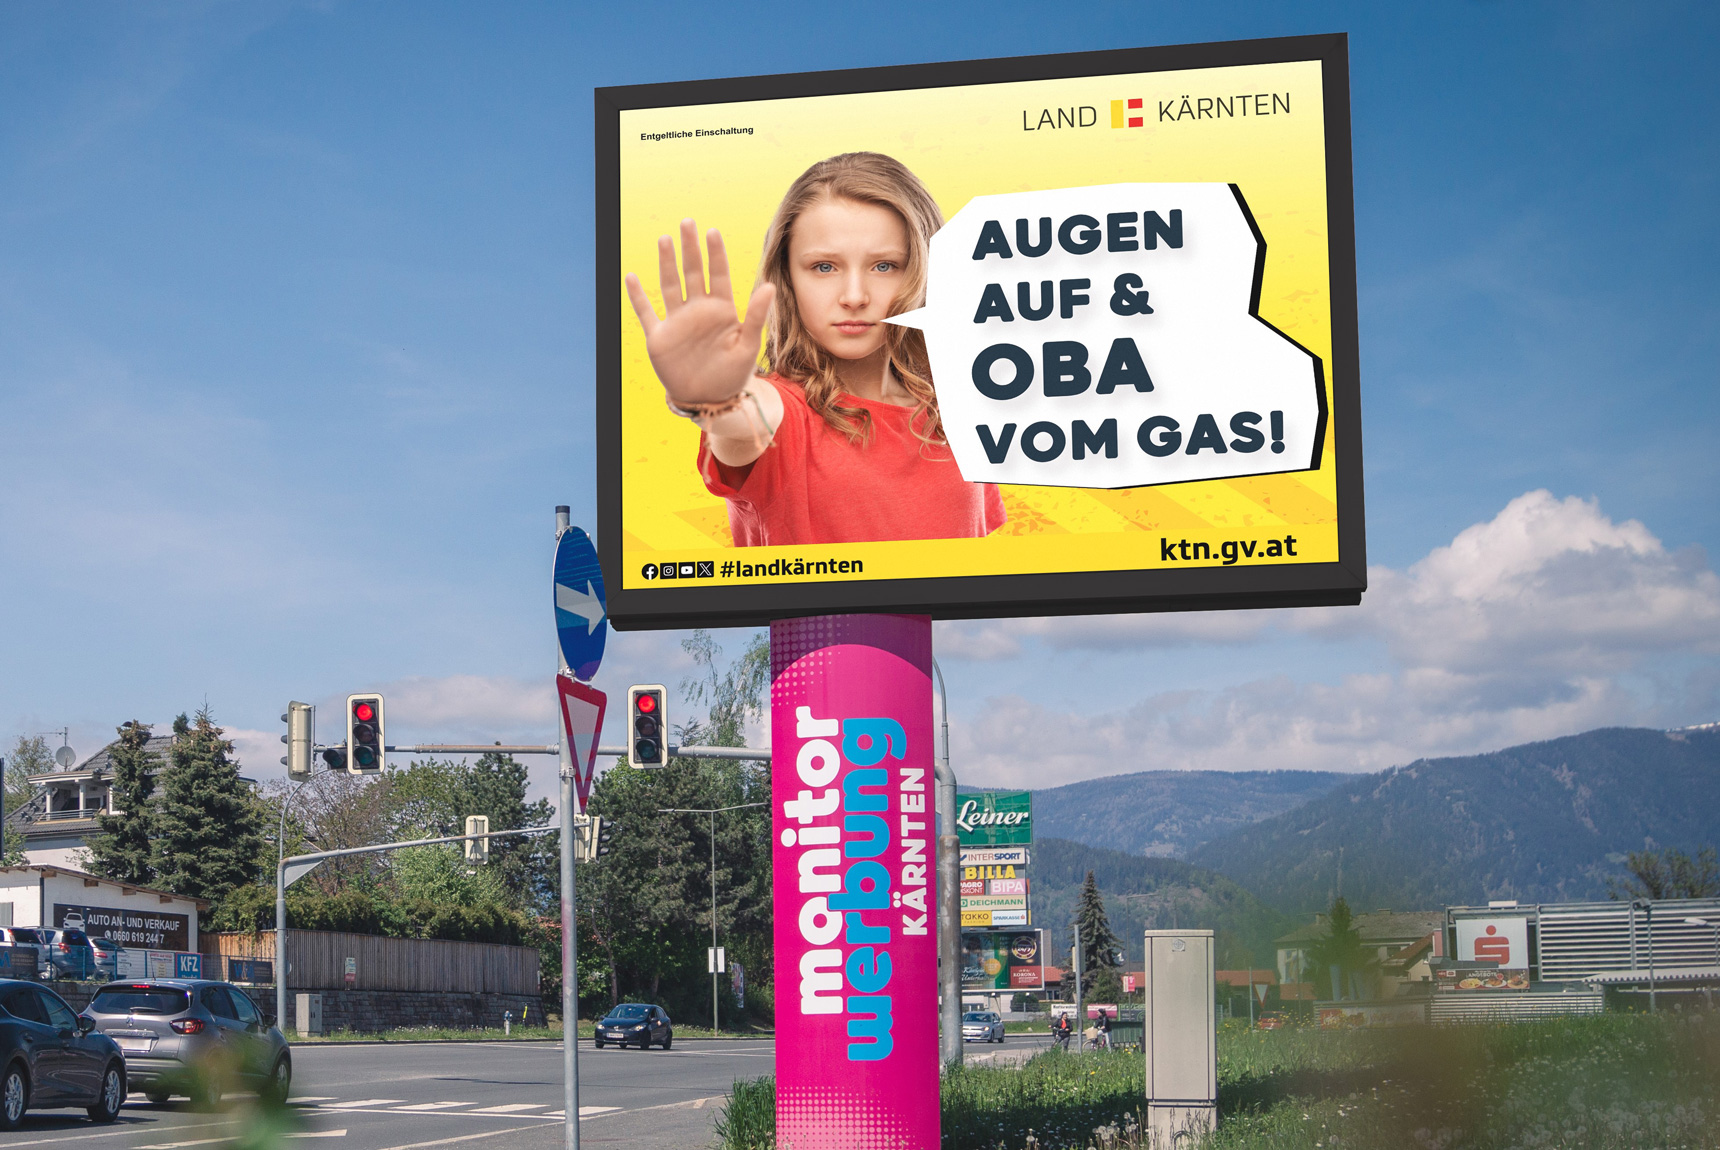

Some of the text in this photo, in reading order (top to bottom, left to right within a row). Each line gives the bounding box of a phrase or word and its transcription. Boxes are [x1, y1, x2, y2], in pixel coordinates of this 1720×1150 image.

[1023, 92, 1290, 132] LAND KÄRNTEN
[640, 127, 754, 142] Entgeltliche Einschaltung
[972, 208, 1184, 260] AUGEN
[973, 272, 1155, 323] AUF &
[971, 337, 1155, 400] OBA
[975, 410, 1286, 464] VOM GAS!
[1160, 535, 1298, 565] ktn.gv.at
[720, 558, 864, 578] #landkärnten
[956, 800, 1029, 832] Leiner
[781, 705, 844, 1015] monitor
[892, 767, 928, 936] KÄRNTEN
[968, 852, 1021, 861] INTERSPORT
[965, 865, 1016, 880] BILLA
[992, 881, 1024, 893] BIPA
[827, 717, 907, 1062] werbung
[87, 914, 180, 931] AUTO AN- UND VERKAUF
[112, 930, 165, 944] 0660 619 244 7
[180, 955, 199, 972] KFZ
